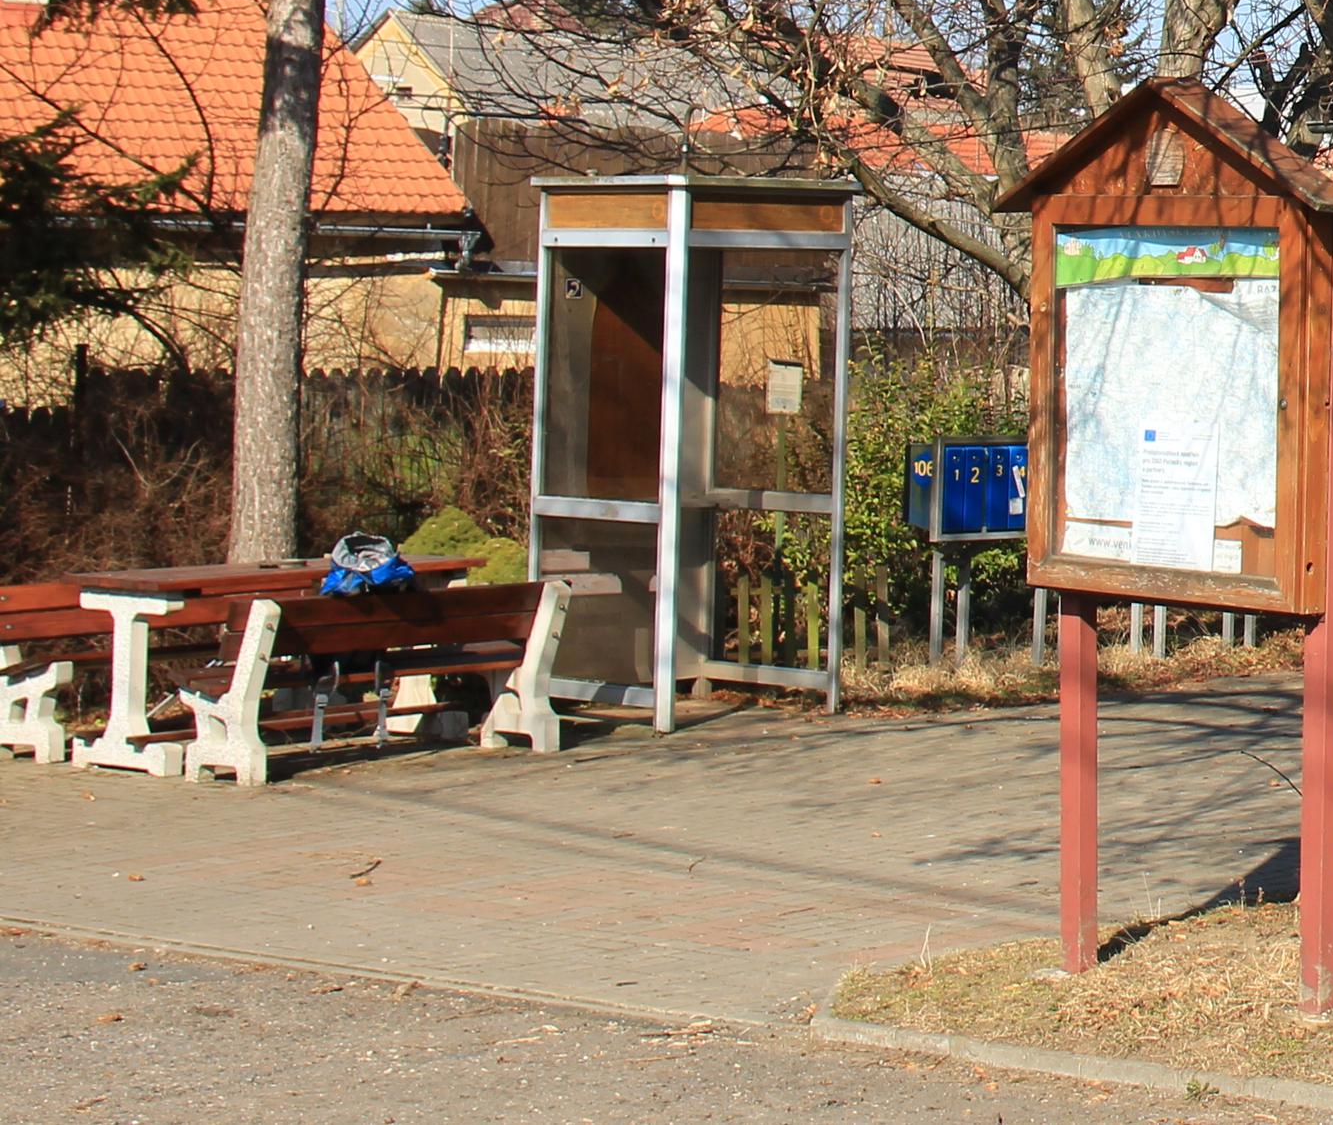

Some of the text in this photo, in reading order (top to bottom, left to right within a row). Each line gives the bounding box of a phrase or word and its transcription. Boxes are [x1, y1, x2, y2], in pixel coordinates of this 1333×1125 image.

[954, 469, 960, 481] 1
[970, 467, 980, 483] 2
[996, 464, 1004, 477] 3
